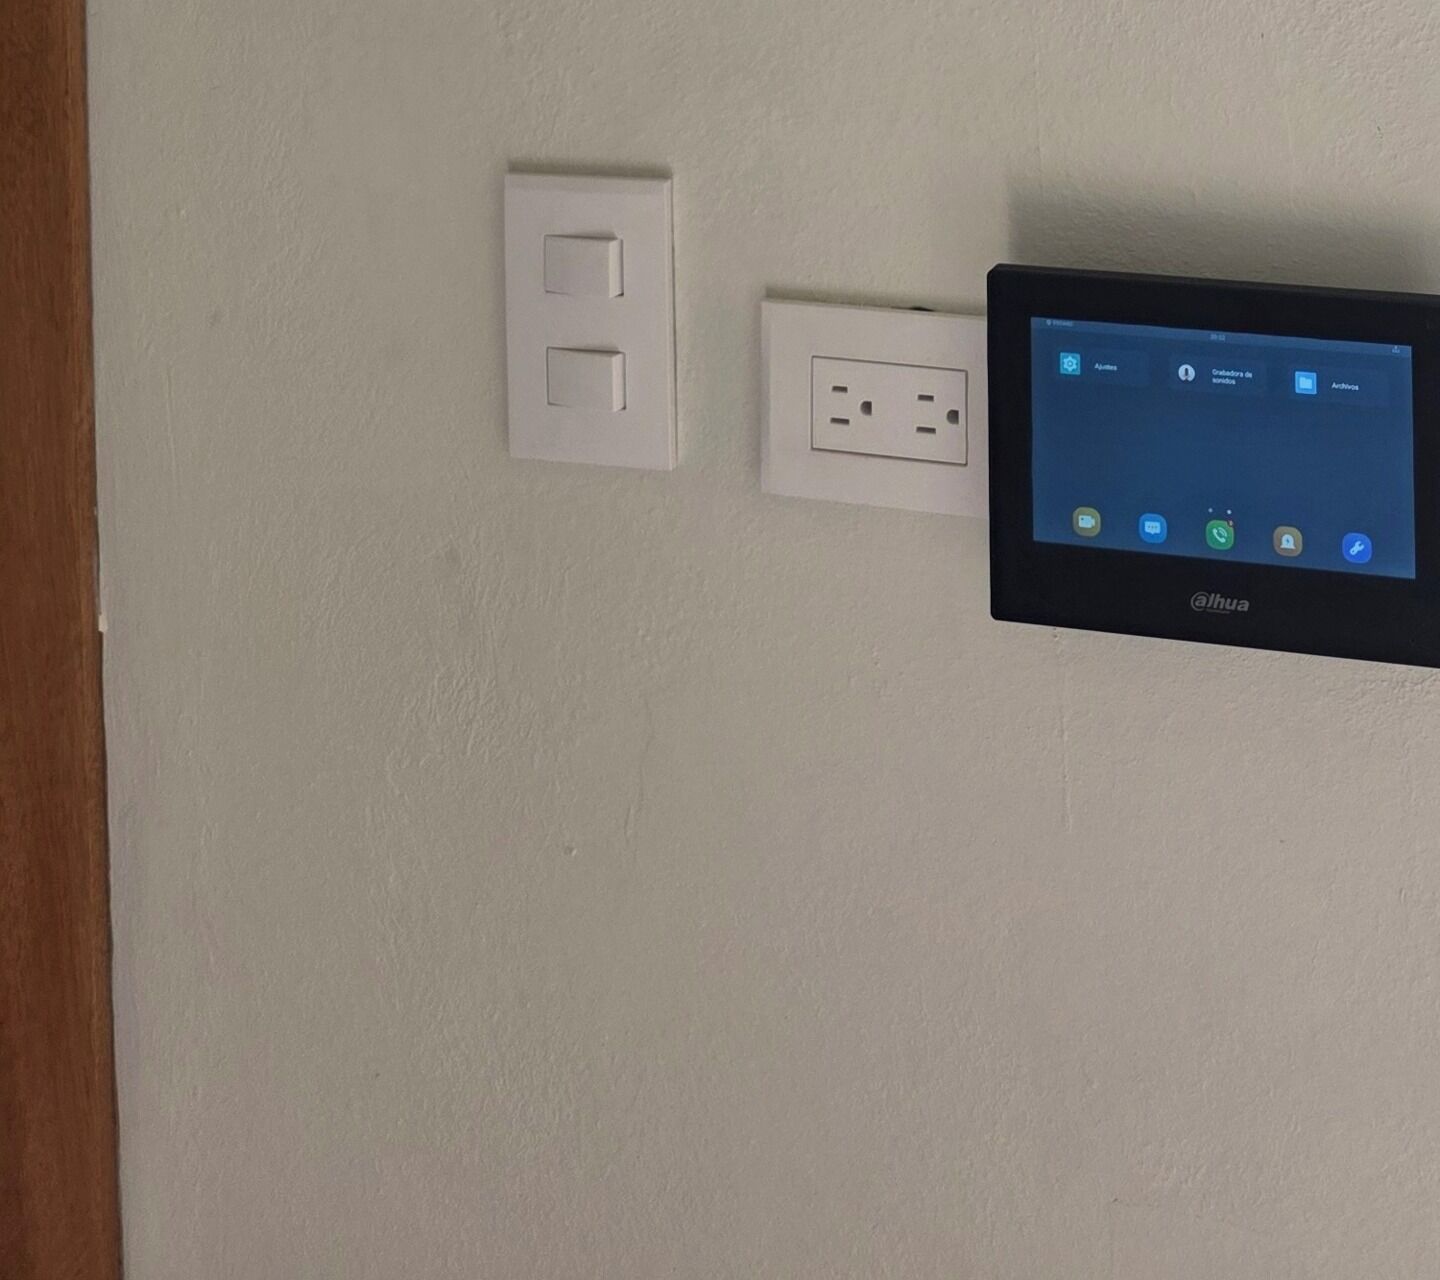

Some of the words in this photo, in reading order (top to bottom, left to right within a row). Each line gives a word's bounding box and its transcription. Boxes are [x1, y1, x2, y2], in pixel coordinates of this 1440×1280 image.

[1094, 362, 1118, 371] Ajustes
[1211, 368, 1243, 378] Grabadora
[1244, 369, 1253, 378] de
[1212, 377, 1236, 385] sonidos
[1331, 380, 1359, 391] Archivos
